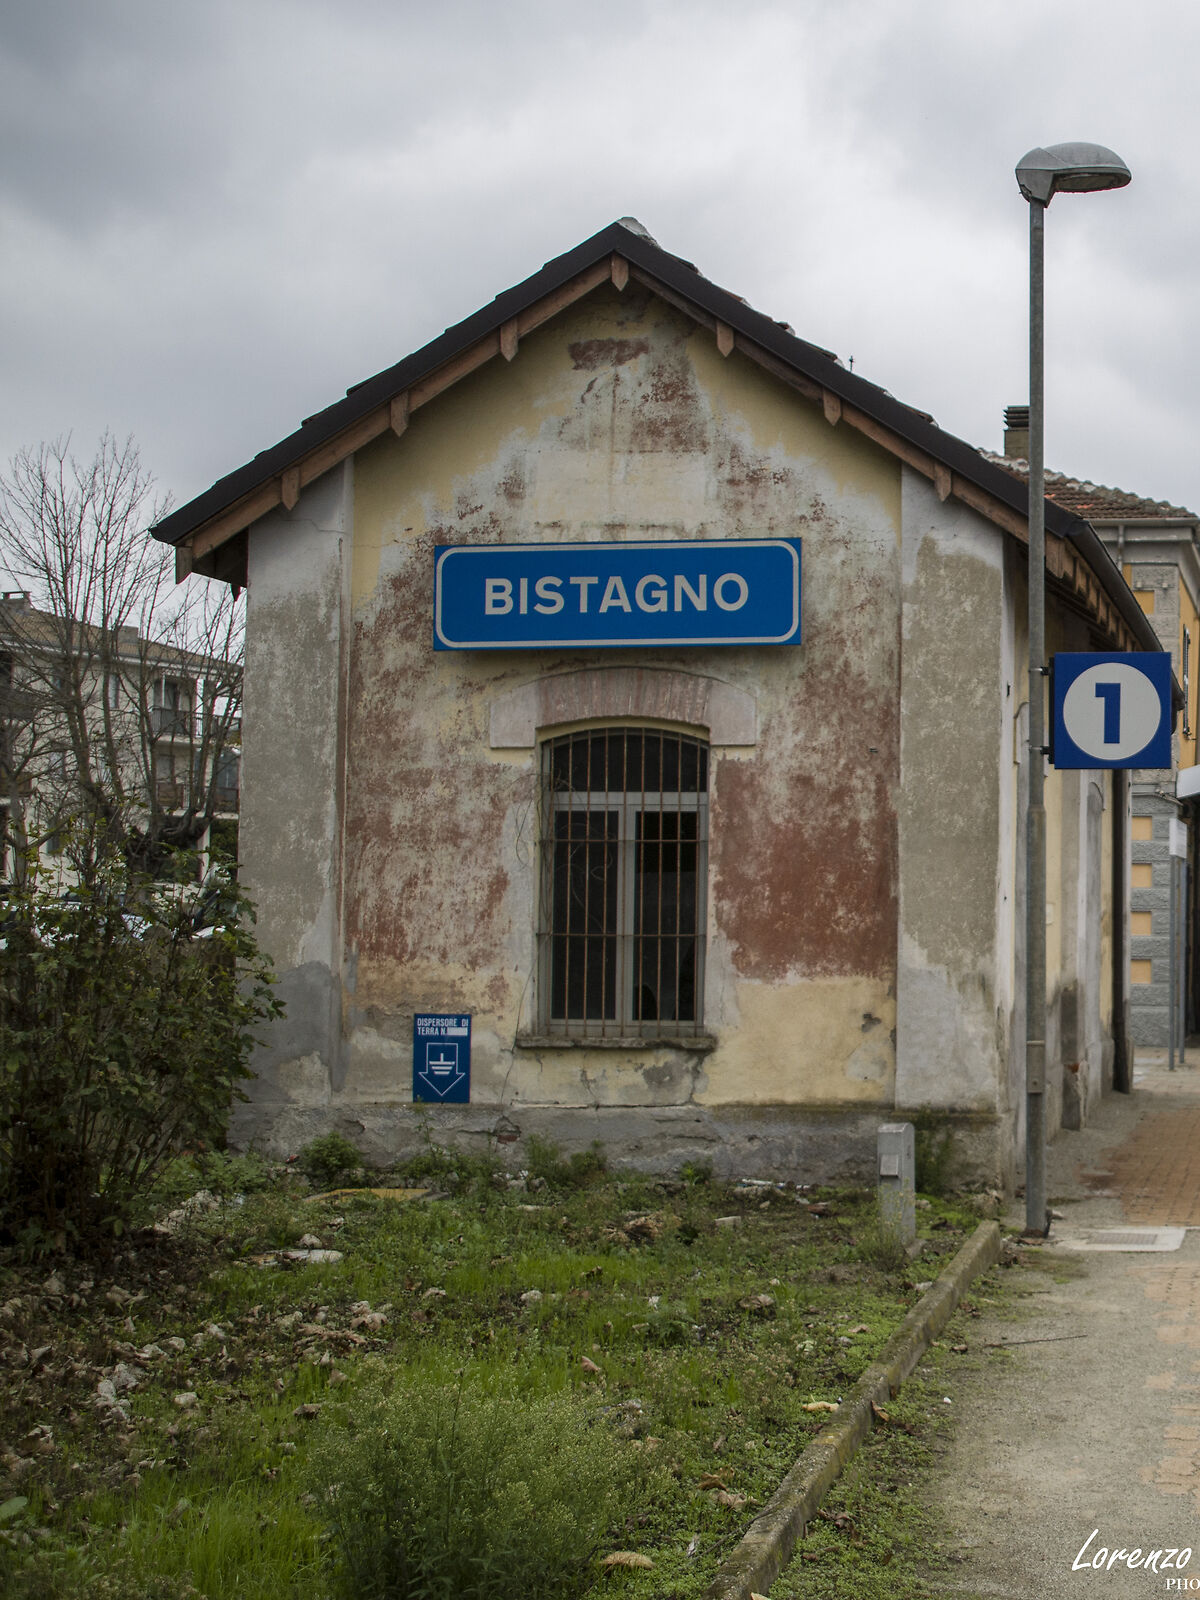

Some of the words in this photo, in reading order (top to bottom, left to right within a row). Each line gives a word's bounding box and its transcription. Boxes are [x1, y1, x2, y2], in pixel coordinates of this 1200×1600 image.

[484, 573, 749, 615] BISTAGNO
[1095, 682, 1121, 744] 1
[417, 1018, 457, 1027] DISPERSORE
[461, 1018, 469, 1027] DI
[417, 1027, 439, 1036] TERRA
